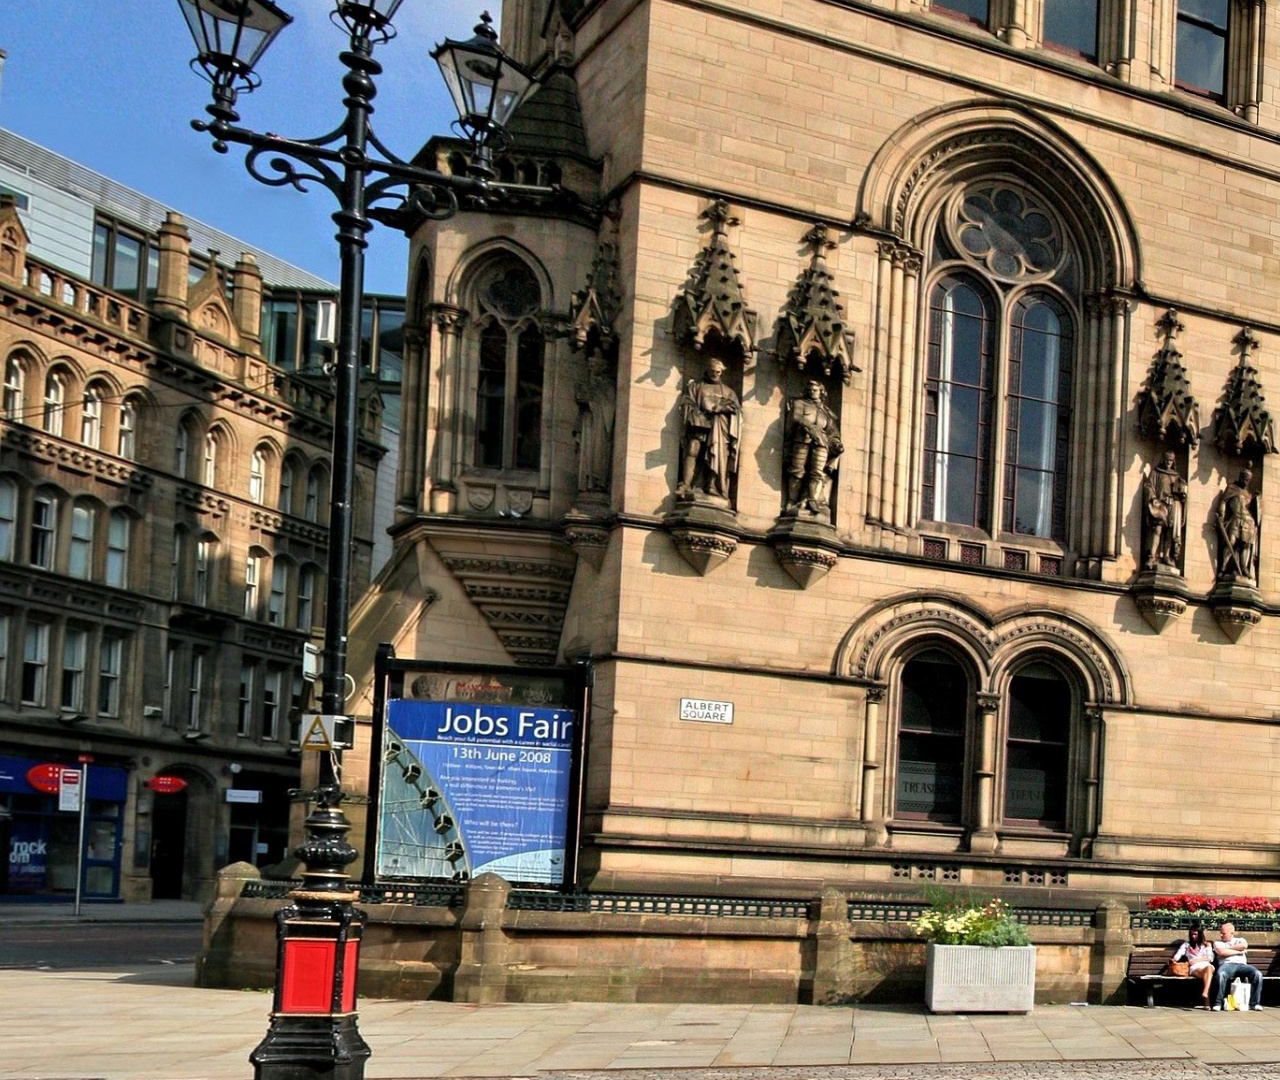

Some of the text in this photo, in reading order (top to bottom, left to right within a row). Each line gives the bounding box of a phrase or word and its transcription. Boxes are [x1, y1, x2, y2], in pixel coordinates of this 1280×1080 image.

[685, 701, 729, 712] ALBERT
[683, 710, 726, 721] SQUARE
[438, 708, 572, 740] Jobs Fair
[453, 747, 551, 764] 13th June 2008
[13, 838, 47, 854] rock
